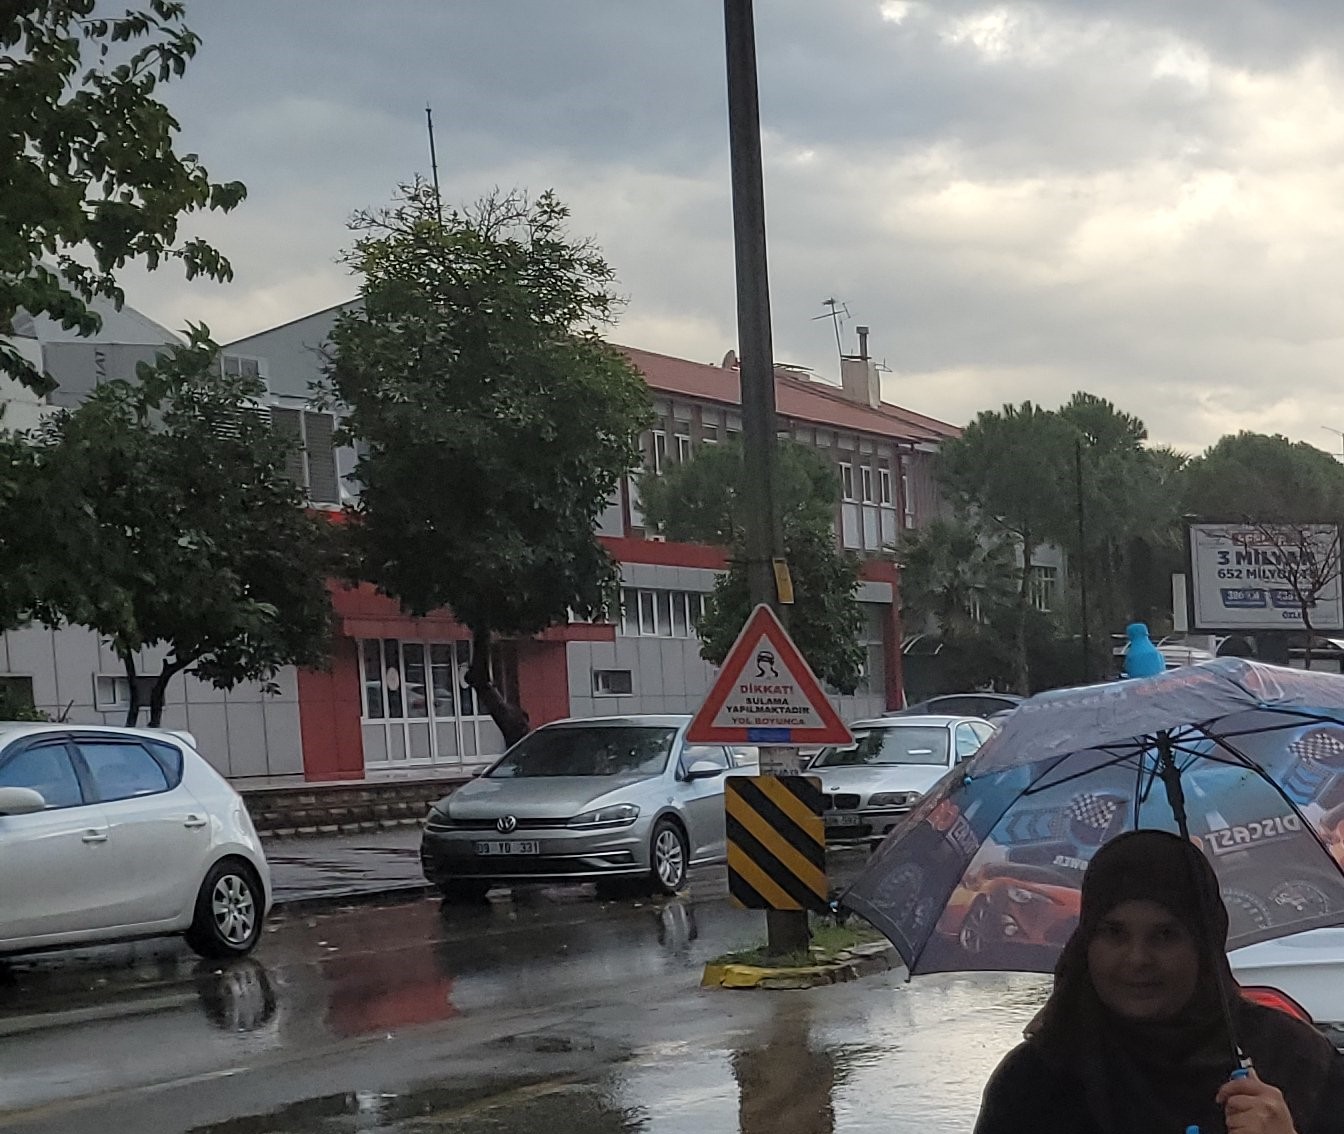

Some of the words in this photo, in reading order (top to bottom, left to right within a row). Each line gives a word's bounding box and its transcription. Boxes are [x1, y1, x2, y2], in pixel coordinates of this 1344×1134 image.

[1217, 551, 1230, 565] 3
[1217, 569, 1242, 579] 652
[740, 683, 794, 695] DİKKAT!
[745, 697, 789, 705] SULAMA
[726, 705, 810, 714] YAPILMAKTADIR
[731, 717, 753, 725] YOL
[755, 717, 805, 725] BOYUNCA
